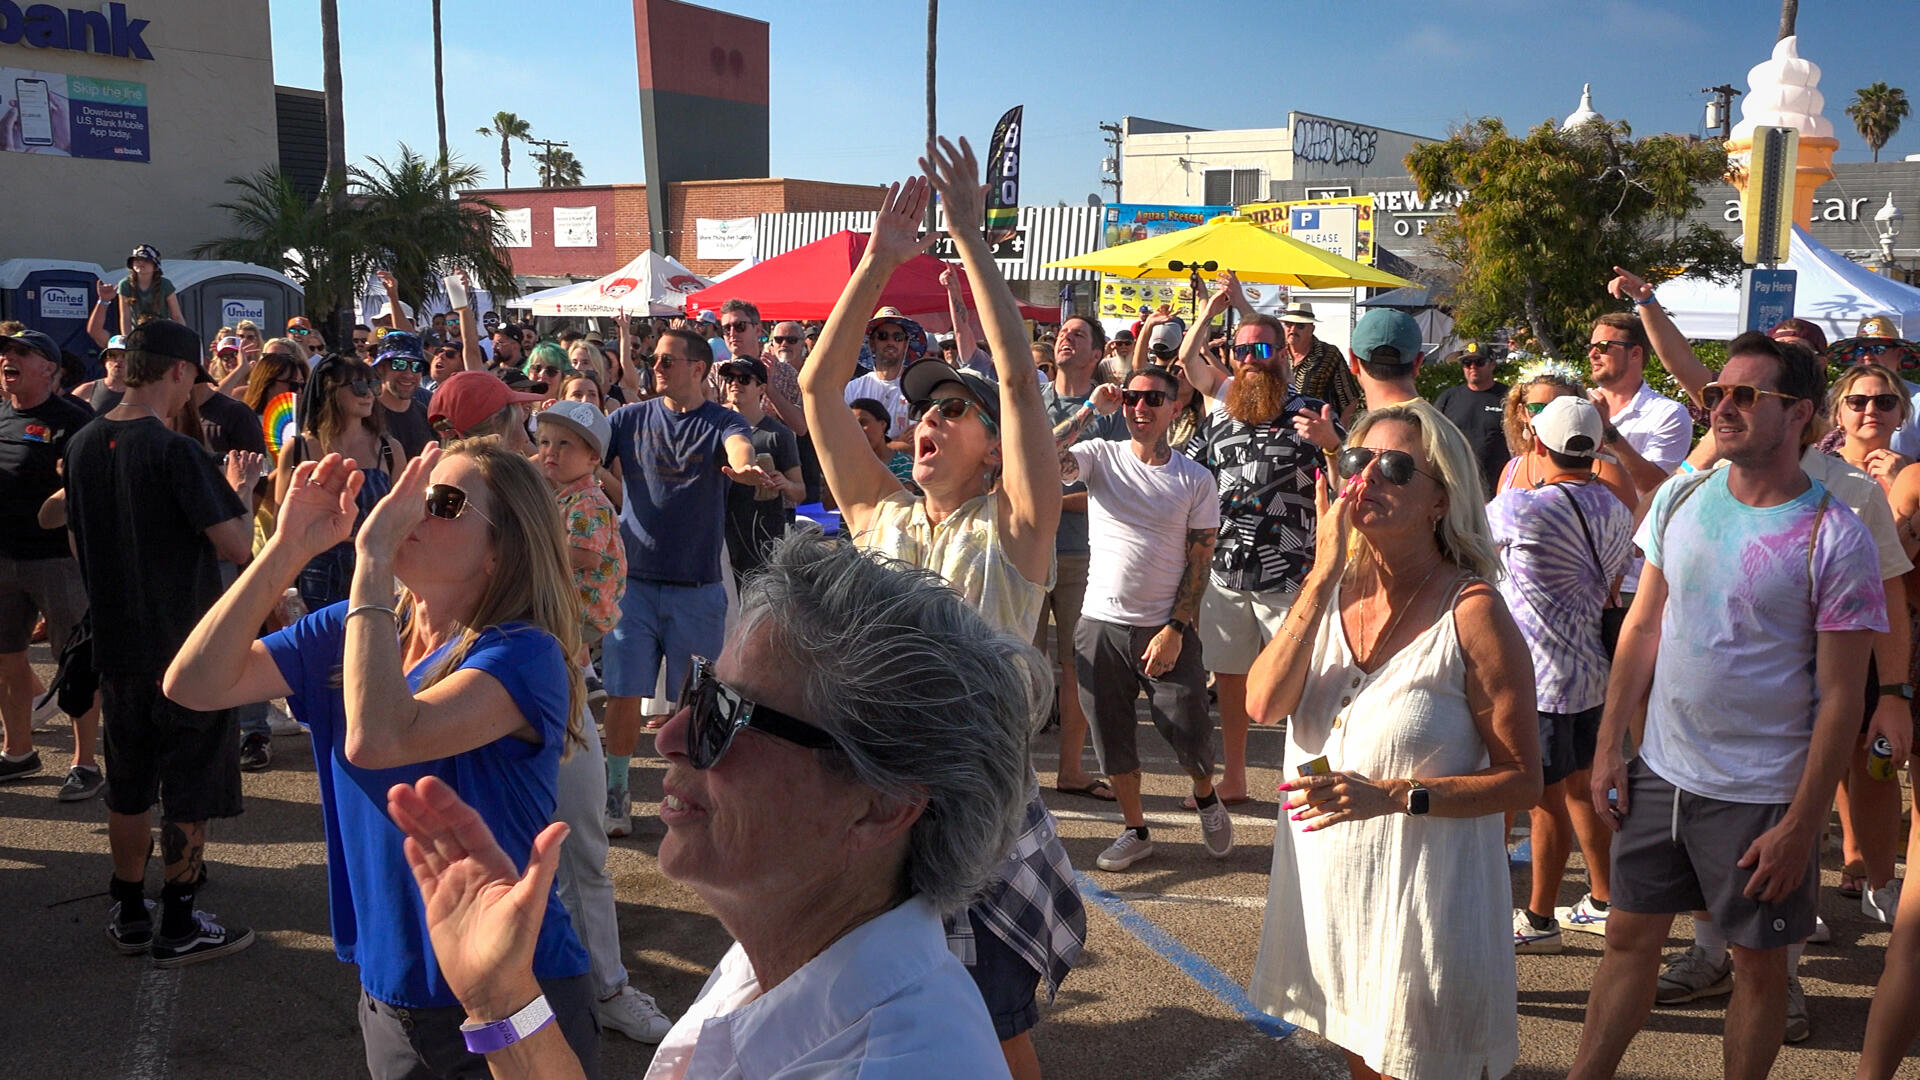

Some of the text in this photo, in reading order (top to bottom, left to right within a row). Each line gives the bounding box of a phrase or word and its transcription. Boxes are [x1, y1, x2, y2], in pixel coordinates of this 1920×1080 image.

[72, 81, 142, 99] Skip the line
[82, 106, 137, 120] Download the
[76, 115, 144, 130] U.S. Bank Mobile
[90, 127, 107, 138] App
[1135, 209, 1204, 225] Aguas Frescas
[1301, 212, 1313, 227] P
[1306, 233, 1339, 243] PLEASE
[1755, 281, 1792, 294] Pay Here
[47, 293, 84, 303] United
[227, 307, 263, 318] United
